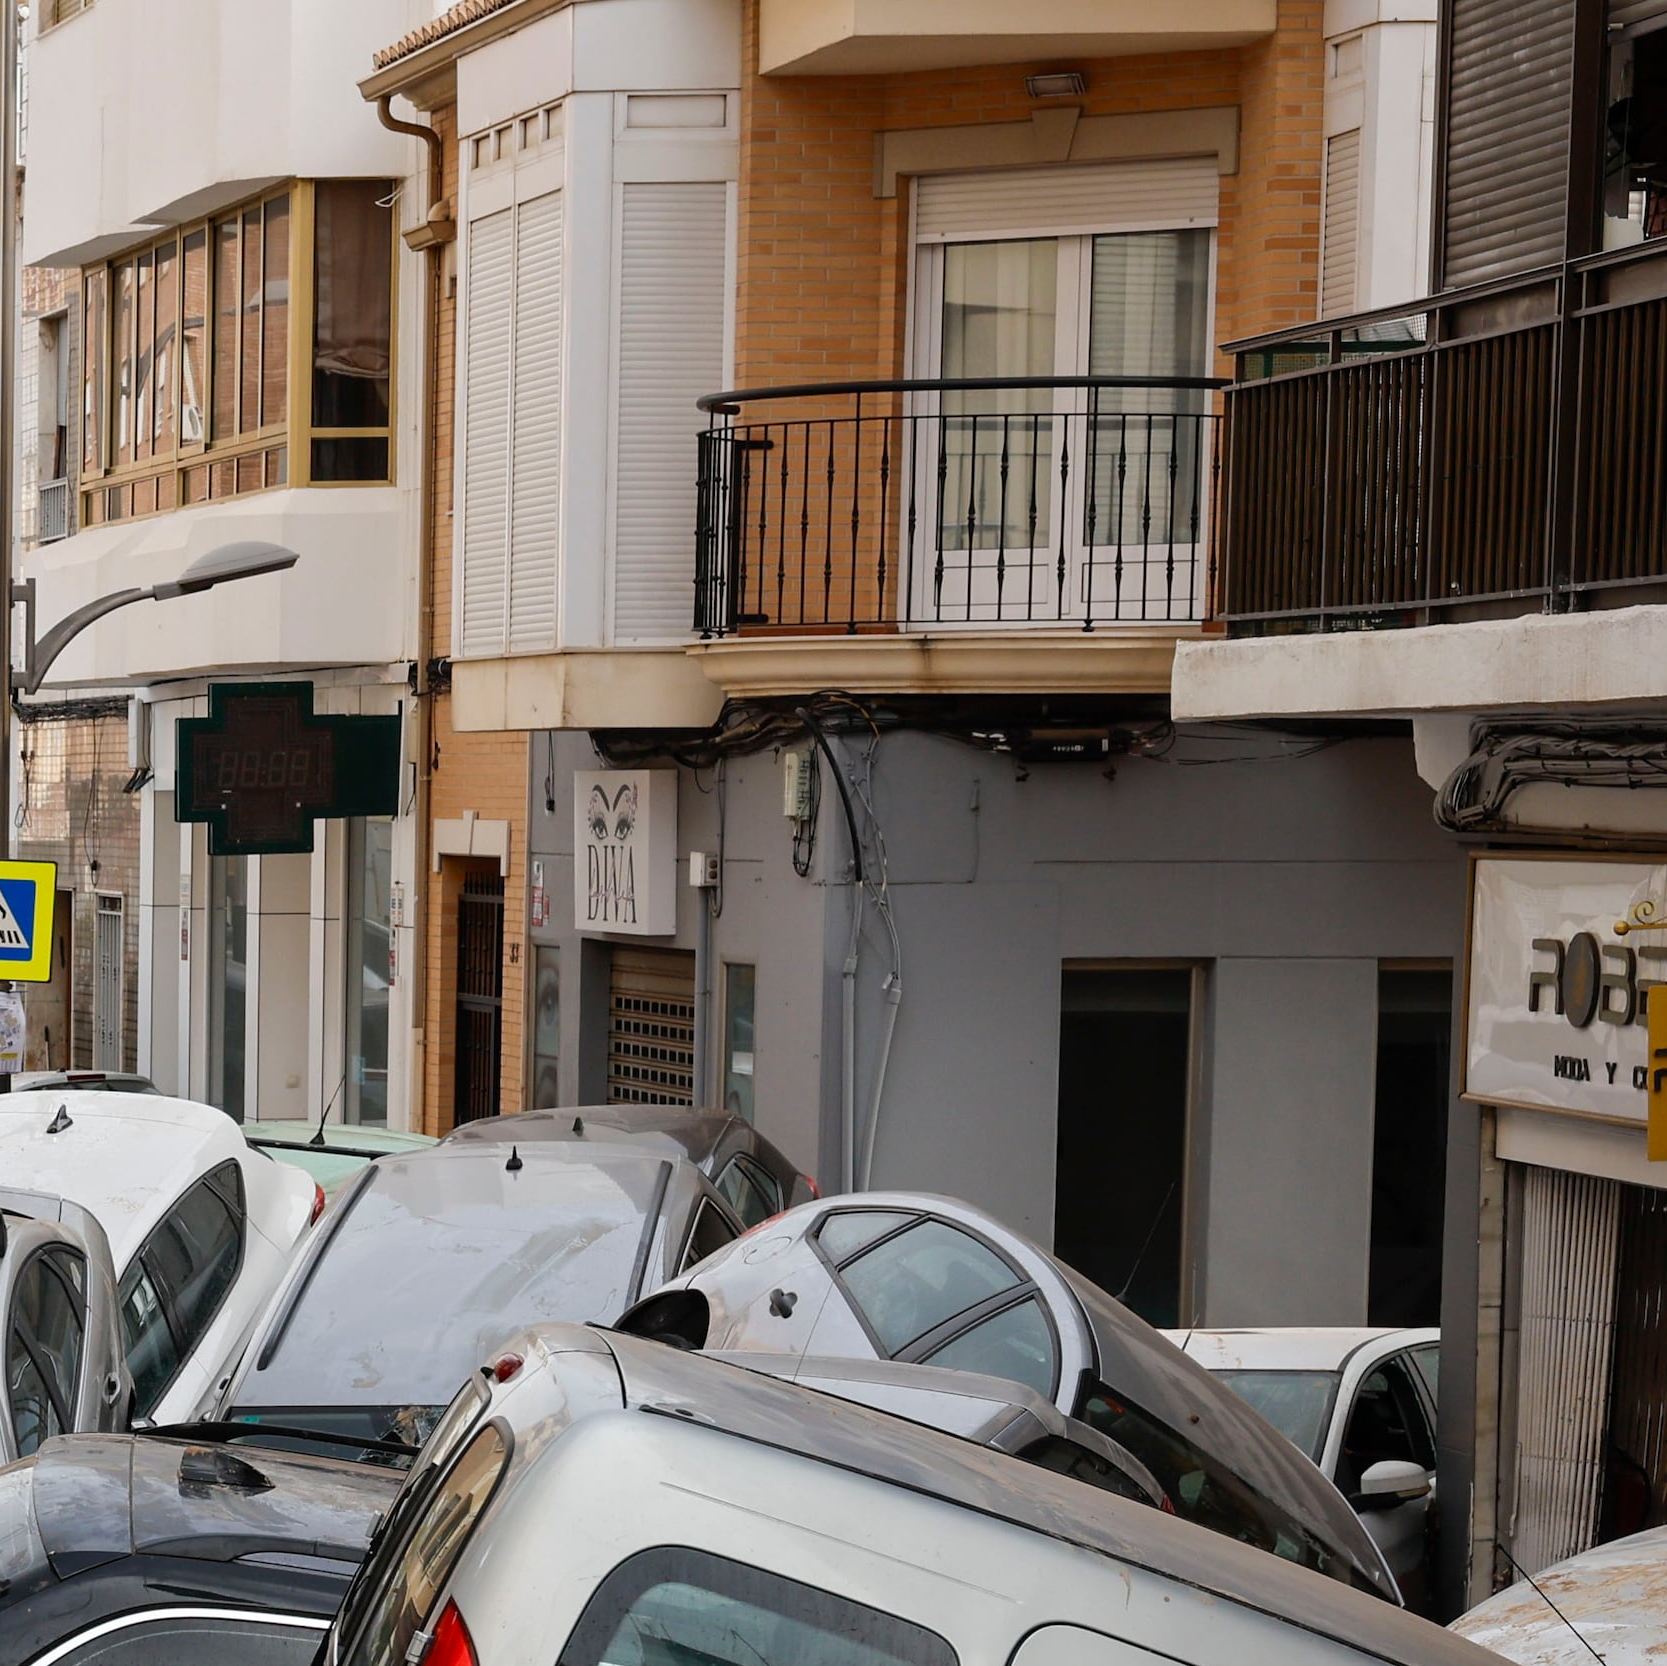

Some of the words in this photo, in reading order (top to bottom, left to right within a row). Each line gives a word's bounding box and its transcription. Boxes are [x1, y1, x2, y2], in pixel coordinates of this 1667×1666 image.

[586, 844, 638, 924] DIVA
[1554, 1054, 1591, 1082] MODA
[1605, 1061, 1618, 1085] Y
